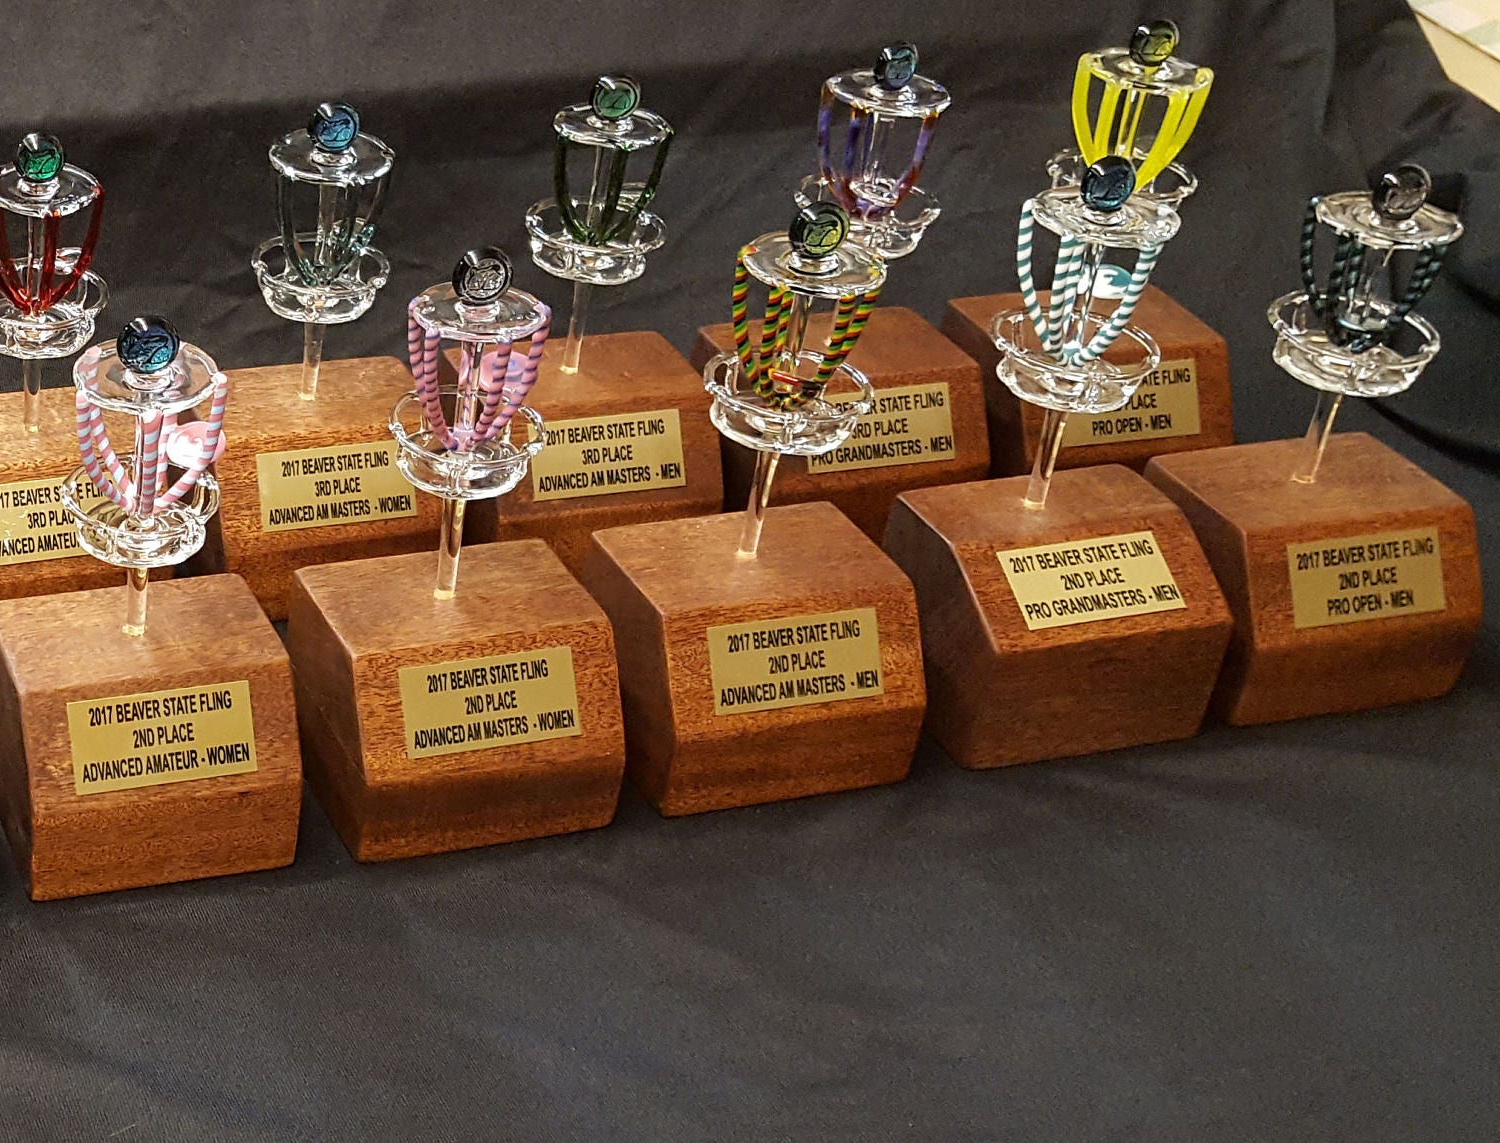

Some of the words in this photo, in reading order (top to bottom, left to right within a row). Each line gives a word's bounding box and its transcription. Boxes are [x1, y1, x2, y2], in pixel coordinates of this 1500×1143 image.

[1162, 368, 1191, 385] FLING
[880, 396, 912, 413] STATE
[914, 391, 944, 409] FLING
[546, 429, 565, 446] 2017
[568, 425, 605, 443] BEAVER
[607, 422, 635, 439] STATE
[638, 419, 665, 436] FLING
[874, 418, 908, 435] PLACE
[1092, 421, 1113, 436] PRO
[1116, 417, 1142, 434] OPEN
[1150, 414, 1172, 430] MEN
[582, 449, 600, 465] 3RD
[602, 445, 633, 463] PLACE
[836, 439, 922, 463] GRANDMASTERS
[931, 435, 952, 452] MEN
[282, 461, 300, 477] 2017
[302, 456, 336, 475] BEAVER
[338, 454, 364, 471] STATE
[365, 451, 389, 468] FLING
[315, 481, 331, 497] 3RD
[334, 477, 361, 494] PLACE
[539, 472, 588, 493] ADVANCED
[591, 471, 605, 487] AM
[607, 466, 650, 485] MASTERS
[661, 463, 681, 480] MEN
[13, 487, 52, 508] BEAVER
[269, 505, 314, 525] ADVANCED
[316, 503, 328, 520] AM
[331, 499, 370, 518] MASTERS
[379, 495, 411, 513] WOMEN
[28, 511, 46, 529] 3RD
[49, 507, 74, 526] PLAC
[37, 534, 80, 551] AMATEU
[1296, 552, 1320, 570] 2017
[1323, 546, 1366, 566] BEAVER
[1367, 541, 1401, 561] STATE
[1402, 538, 1434, 557] FLING
[1010, 556, 1036, 573] 2017
[1036, 549, 1084, 570] BEAVER
[1082, 544, 1120, 563] STATE
[1118, 540, 1154, 559] FLING
[1061, 573, 1085, 591] 2ND
[1086, 568, 1125, 587] PLACE
[1338, 571, 1360, 590] 2ND
[1362, 567, 1398, 587] PLACE
[1025, 602, 1051, 620] PRO
[1052, 589, 1147, 616] GRANDMASTERS
[1152, 584, 1180, 601] MEN
[1327, 598, 1350, 616] PRO
[1353, 592, 1382, 613] OPEN
[1390, 590, 1414, 608] MEN
[728, 633, 750, 653] 2017
[753, 628, 795, 650] BEAVER
[797, 623, 828, 645] STATE
[830, 620, 860, 640] FLING
[769, 655, 789, 674] 2ND
[792, 650, 826, 672] PLACE
[427, 673, 447, 693] 2017
[450, 668, 488, 690] BEAVER
[490, 663, 519, 684] STATE
[520, 659, 548, 680] FLING
[721, 683, 777, 707] ADVANCED
[779, 681, 795, 700] AM
[797, 674, 846, 698] MASTERS
[857, 670, 879, 689] MEN
[89, 706, 113, 727] 2017
[116, 700, 161, 723] BEAVER
[163, 695, 197, 717] STATE
[199, 690, 232, 713] FLING
[465, 695, 483, 715] 2ND
[486, 690, 518, 712] PLACE
[133, 728, 155, 749] 2ND
[158, 723, 195, 745] PLACE
[414, 725, 465, 749] ADVANCED
[468, 723, 482, 742] AM
[483, 715, 529, 740] MASTERS
[538, 710, 575, 731] WOMEN
[83, 757, 143, 784] ADVANCED
[146, 749, 199, 775] AMATEUR
[206, 743, 250, 766] WOMEN
